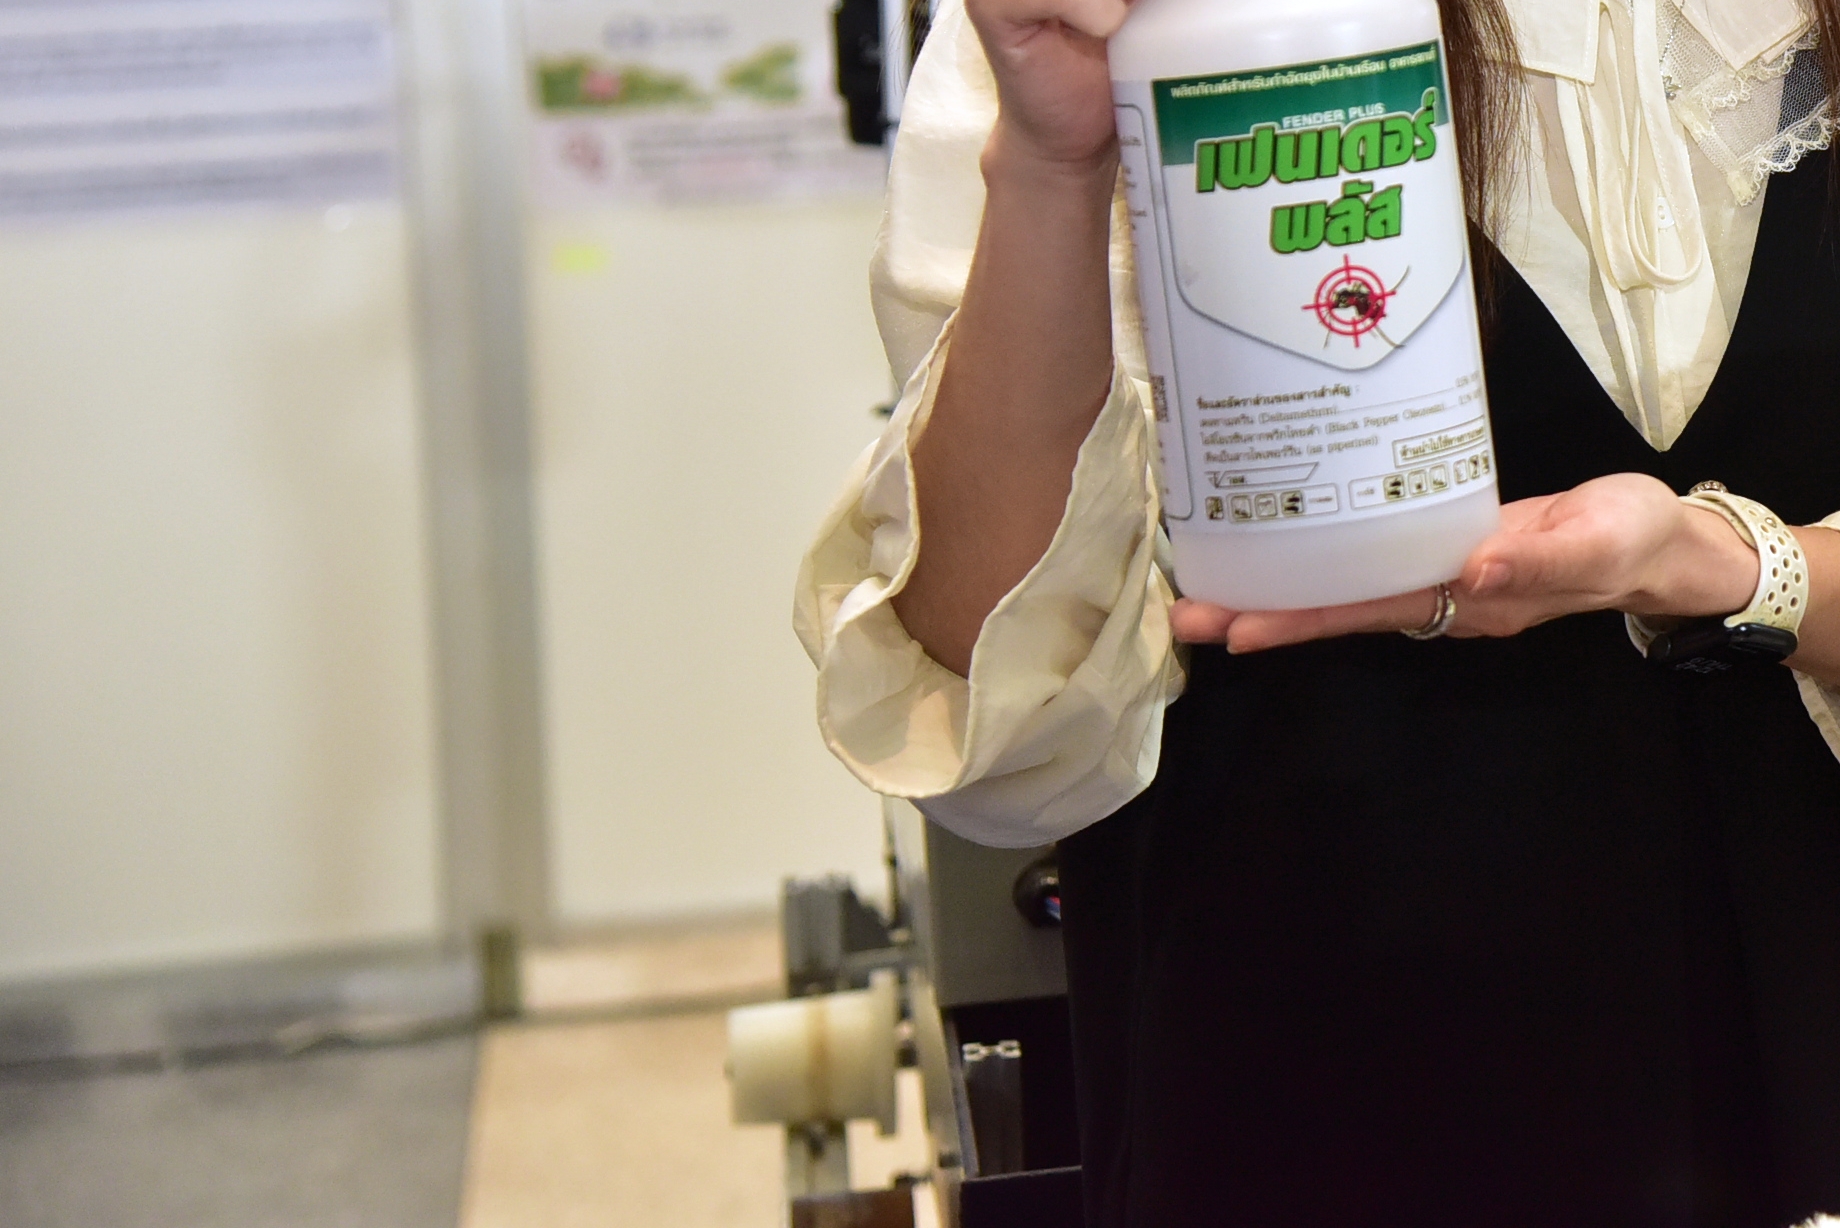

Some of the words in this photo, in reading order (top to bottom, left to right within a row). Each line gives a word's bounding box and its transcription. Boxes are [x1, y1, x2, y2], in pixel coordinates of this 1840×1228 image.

[1195, 87, 1440, 193] เฟนเดอร์
[1282, 109, 1346, 129] FENDER
[1348, 102, 1386, 120] PLUS
[1269, 180, 1403, 254] พลัส
